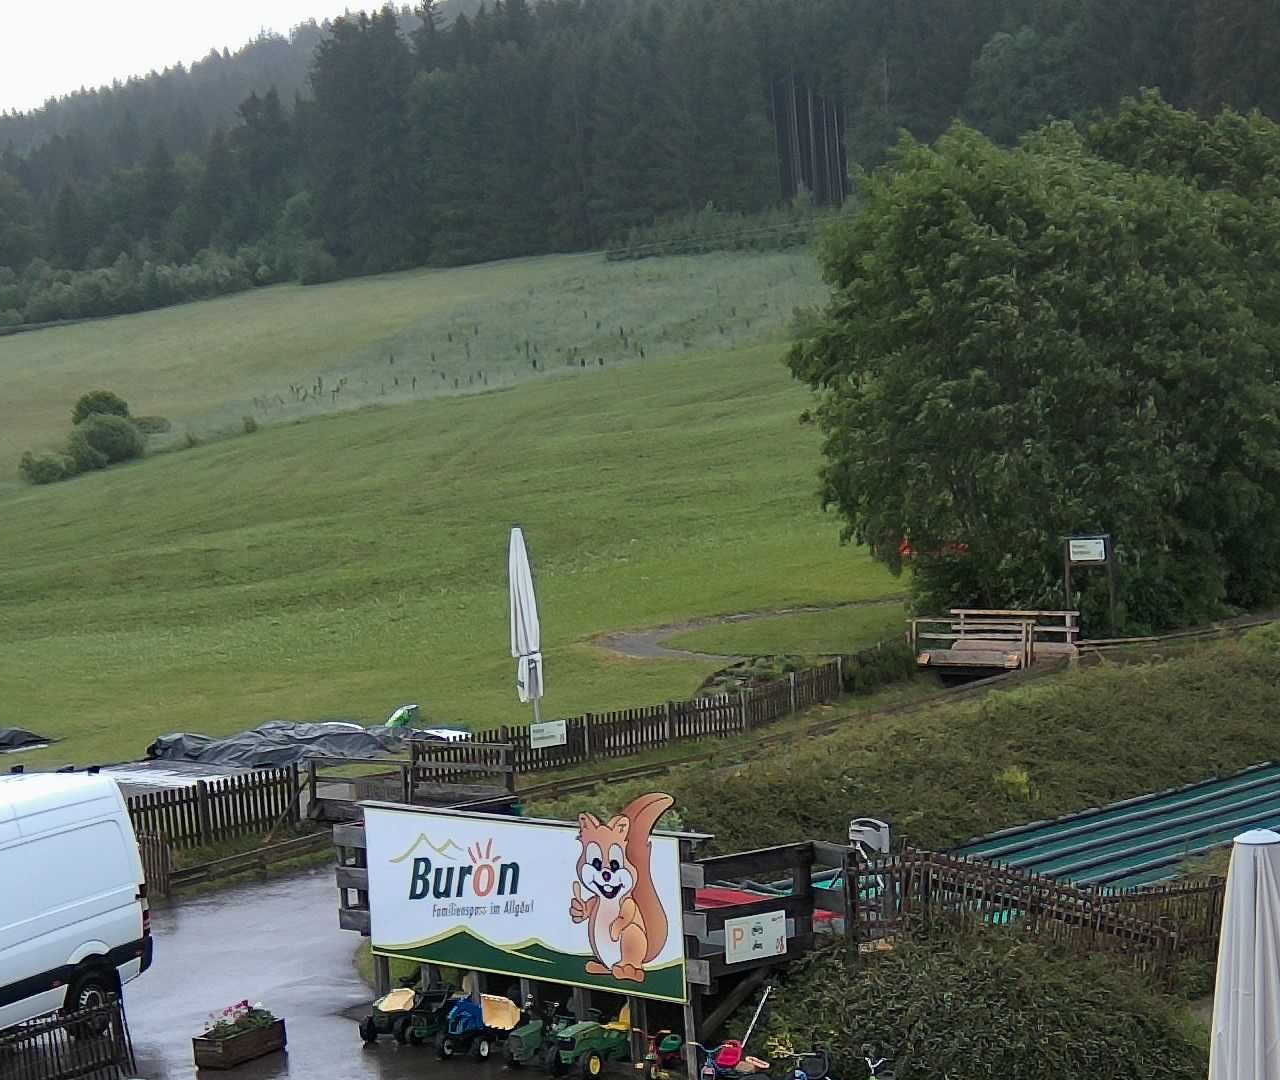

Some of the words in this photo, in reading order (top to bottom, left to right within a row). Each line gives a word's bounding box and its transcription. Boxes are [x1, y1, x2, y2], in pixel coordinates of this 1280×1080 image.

[409, 853, 520, 900] Buron
[489, 902, 500, 915] im
[733, 927, 745, 951] P
